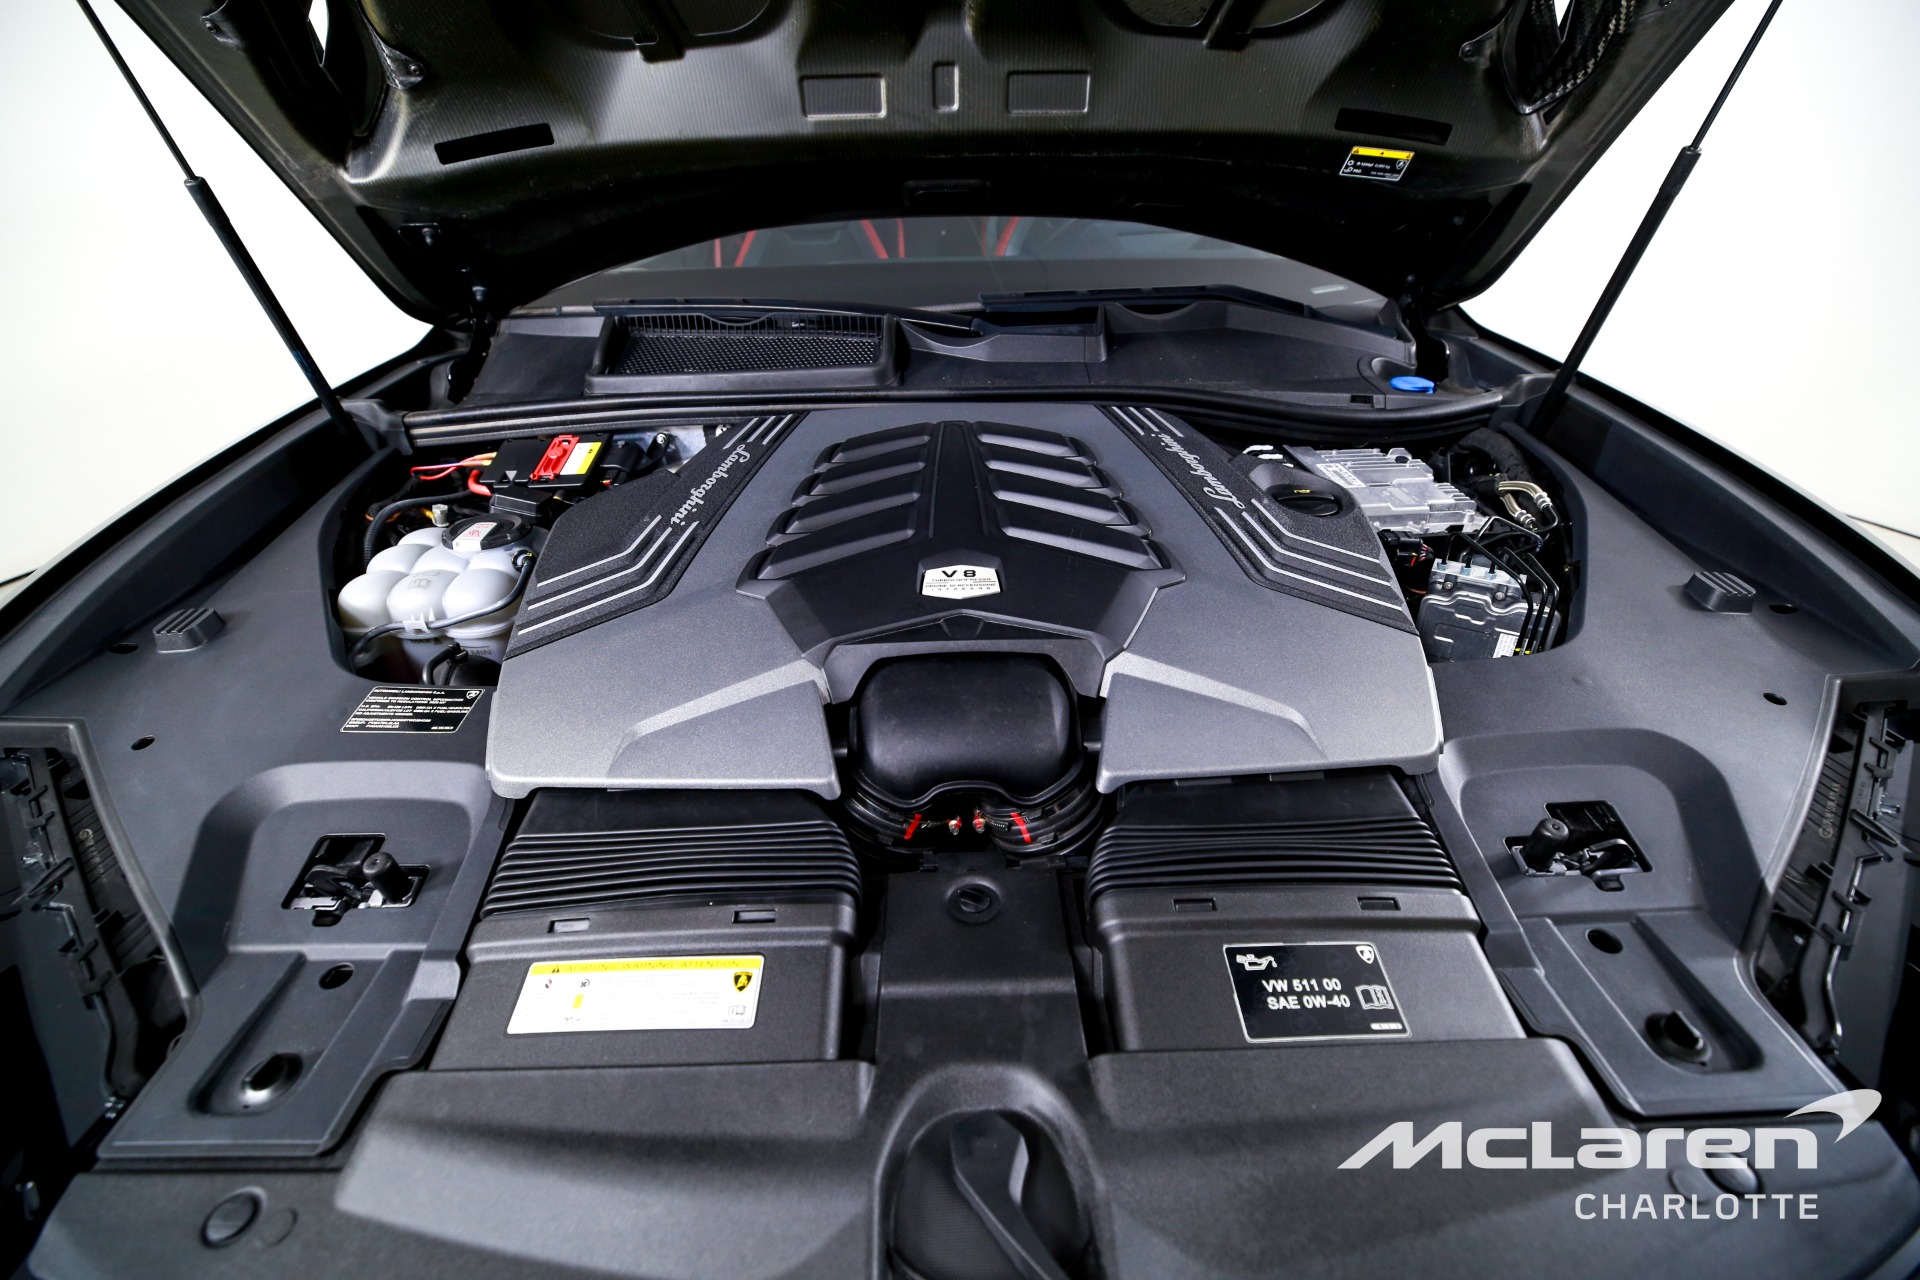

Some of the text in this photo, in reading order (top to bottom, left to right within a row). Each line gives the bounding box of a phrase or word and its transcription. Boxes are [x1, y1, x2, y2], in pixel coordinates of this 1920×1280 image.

[1151, 432, 1246, 509] Lamborghini
[670, 444, 751, 526] Lamborghini
[566, 960, 740, 973] ACHTUNG WARNING ATTENTION
[1262, 978, 1342, 992] VW 511 00
[1267, 995, 1351, 1009] SAE 0W-40
